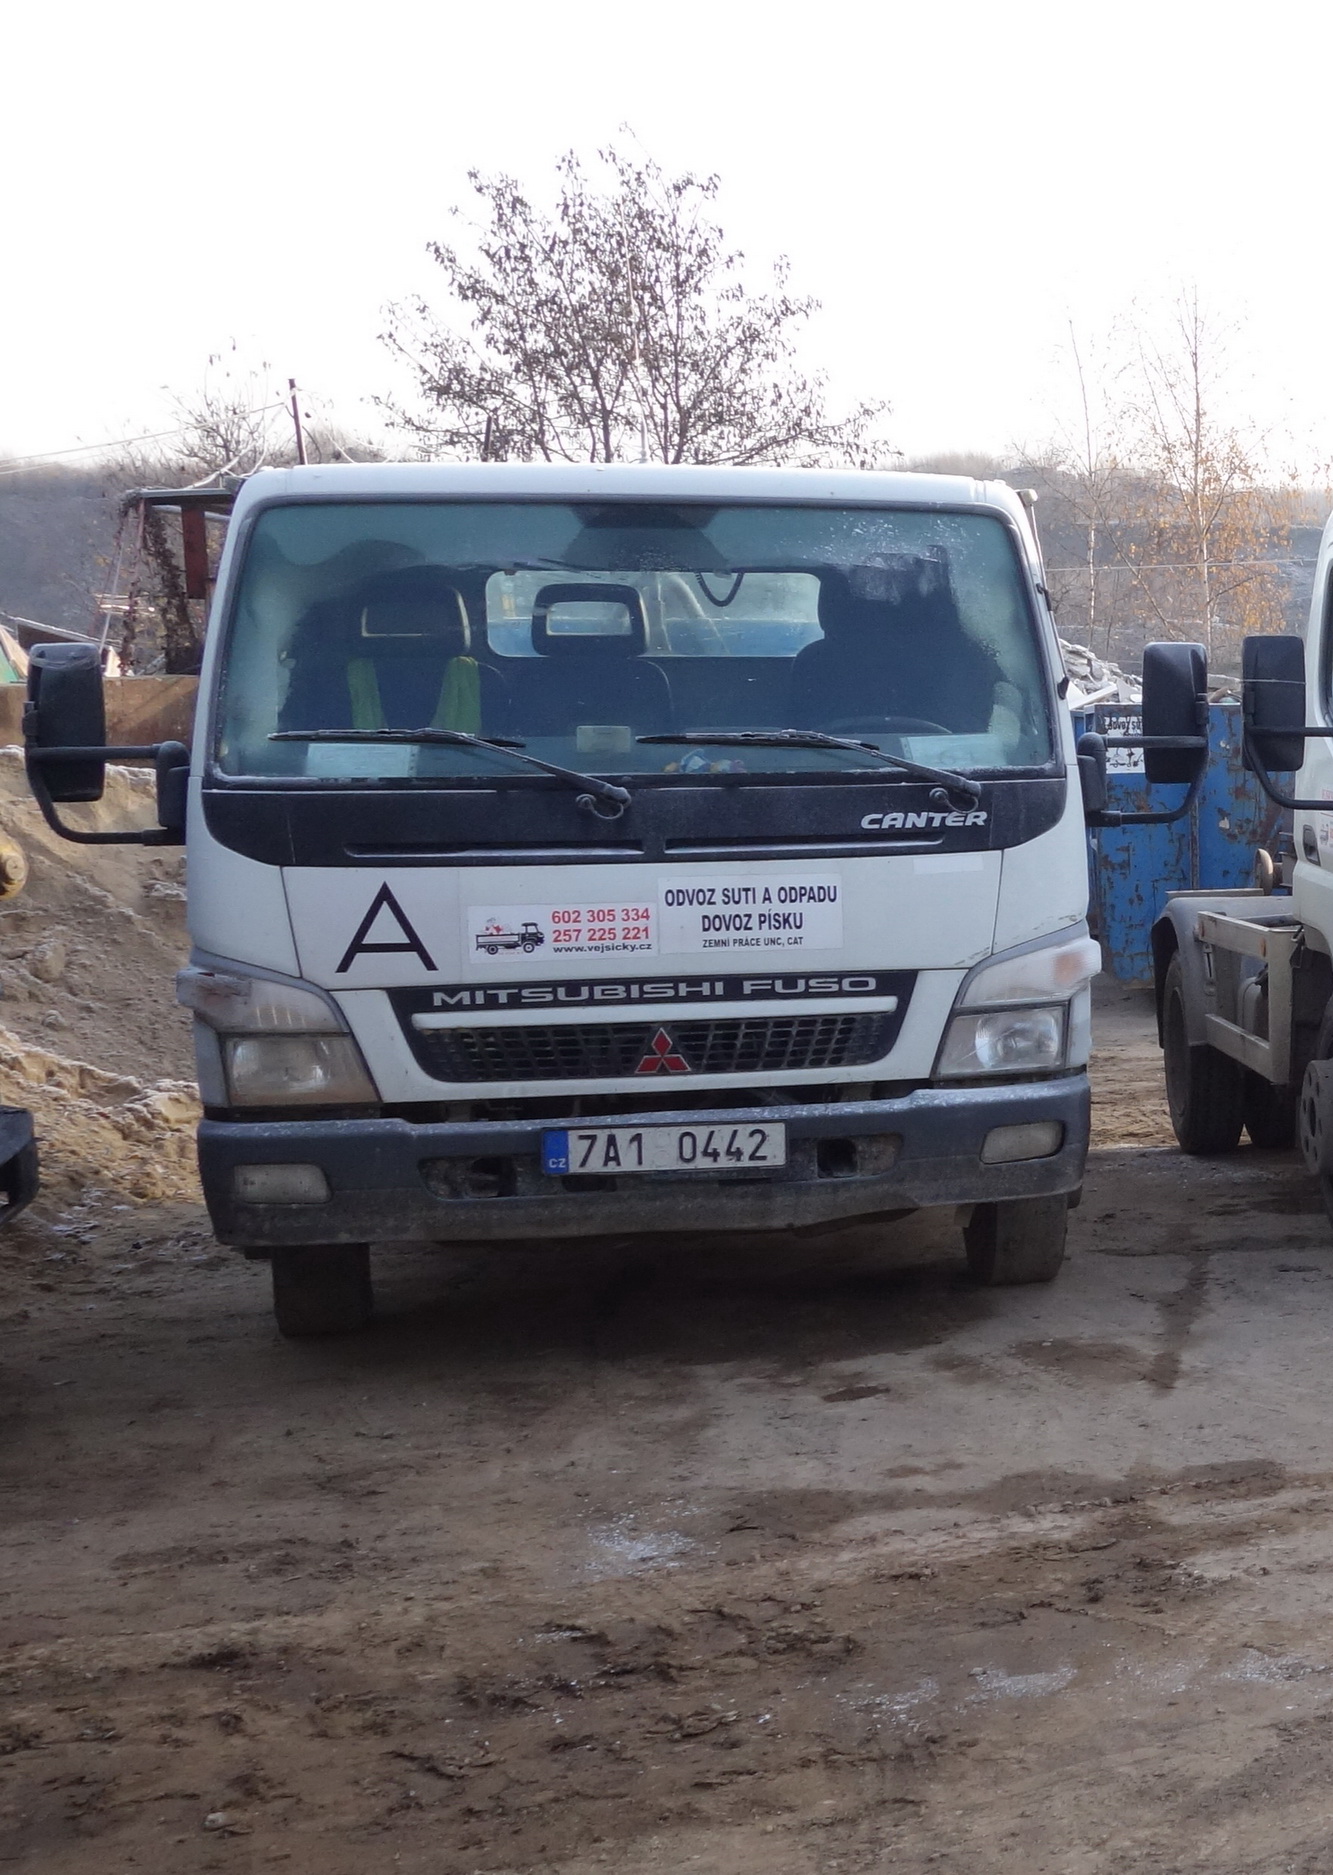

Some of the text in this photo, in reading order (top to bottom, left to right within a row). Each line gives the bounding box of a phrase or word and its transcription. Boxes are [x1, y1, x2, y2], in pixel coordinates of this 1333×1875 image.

[860, 811, 988, 830] CANTER
[664, 885, 838, 907] ODVOZ SUTI A ODPADU
[552, 908, 650, 924] 602 305 334
[702, 909, 804, 932] DOVOZ PÍSKU
[335, 881, 439, 973] A
[552, 927, 650, 943] 257 225 221
[553, 942, 652, 955] www.vejsicky.cz
[702, 935, 804, 948] ZEMNÍ PRÁCE UNC, CAT
[433, 977, 876, 1006] MITSUBISHI FUSO
[578, 1128, 770, 1168] 7A1 0442
[548, 1158, 567, 1168] CZ
